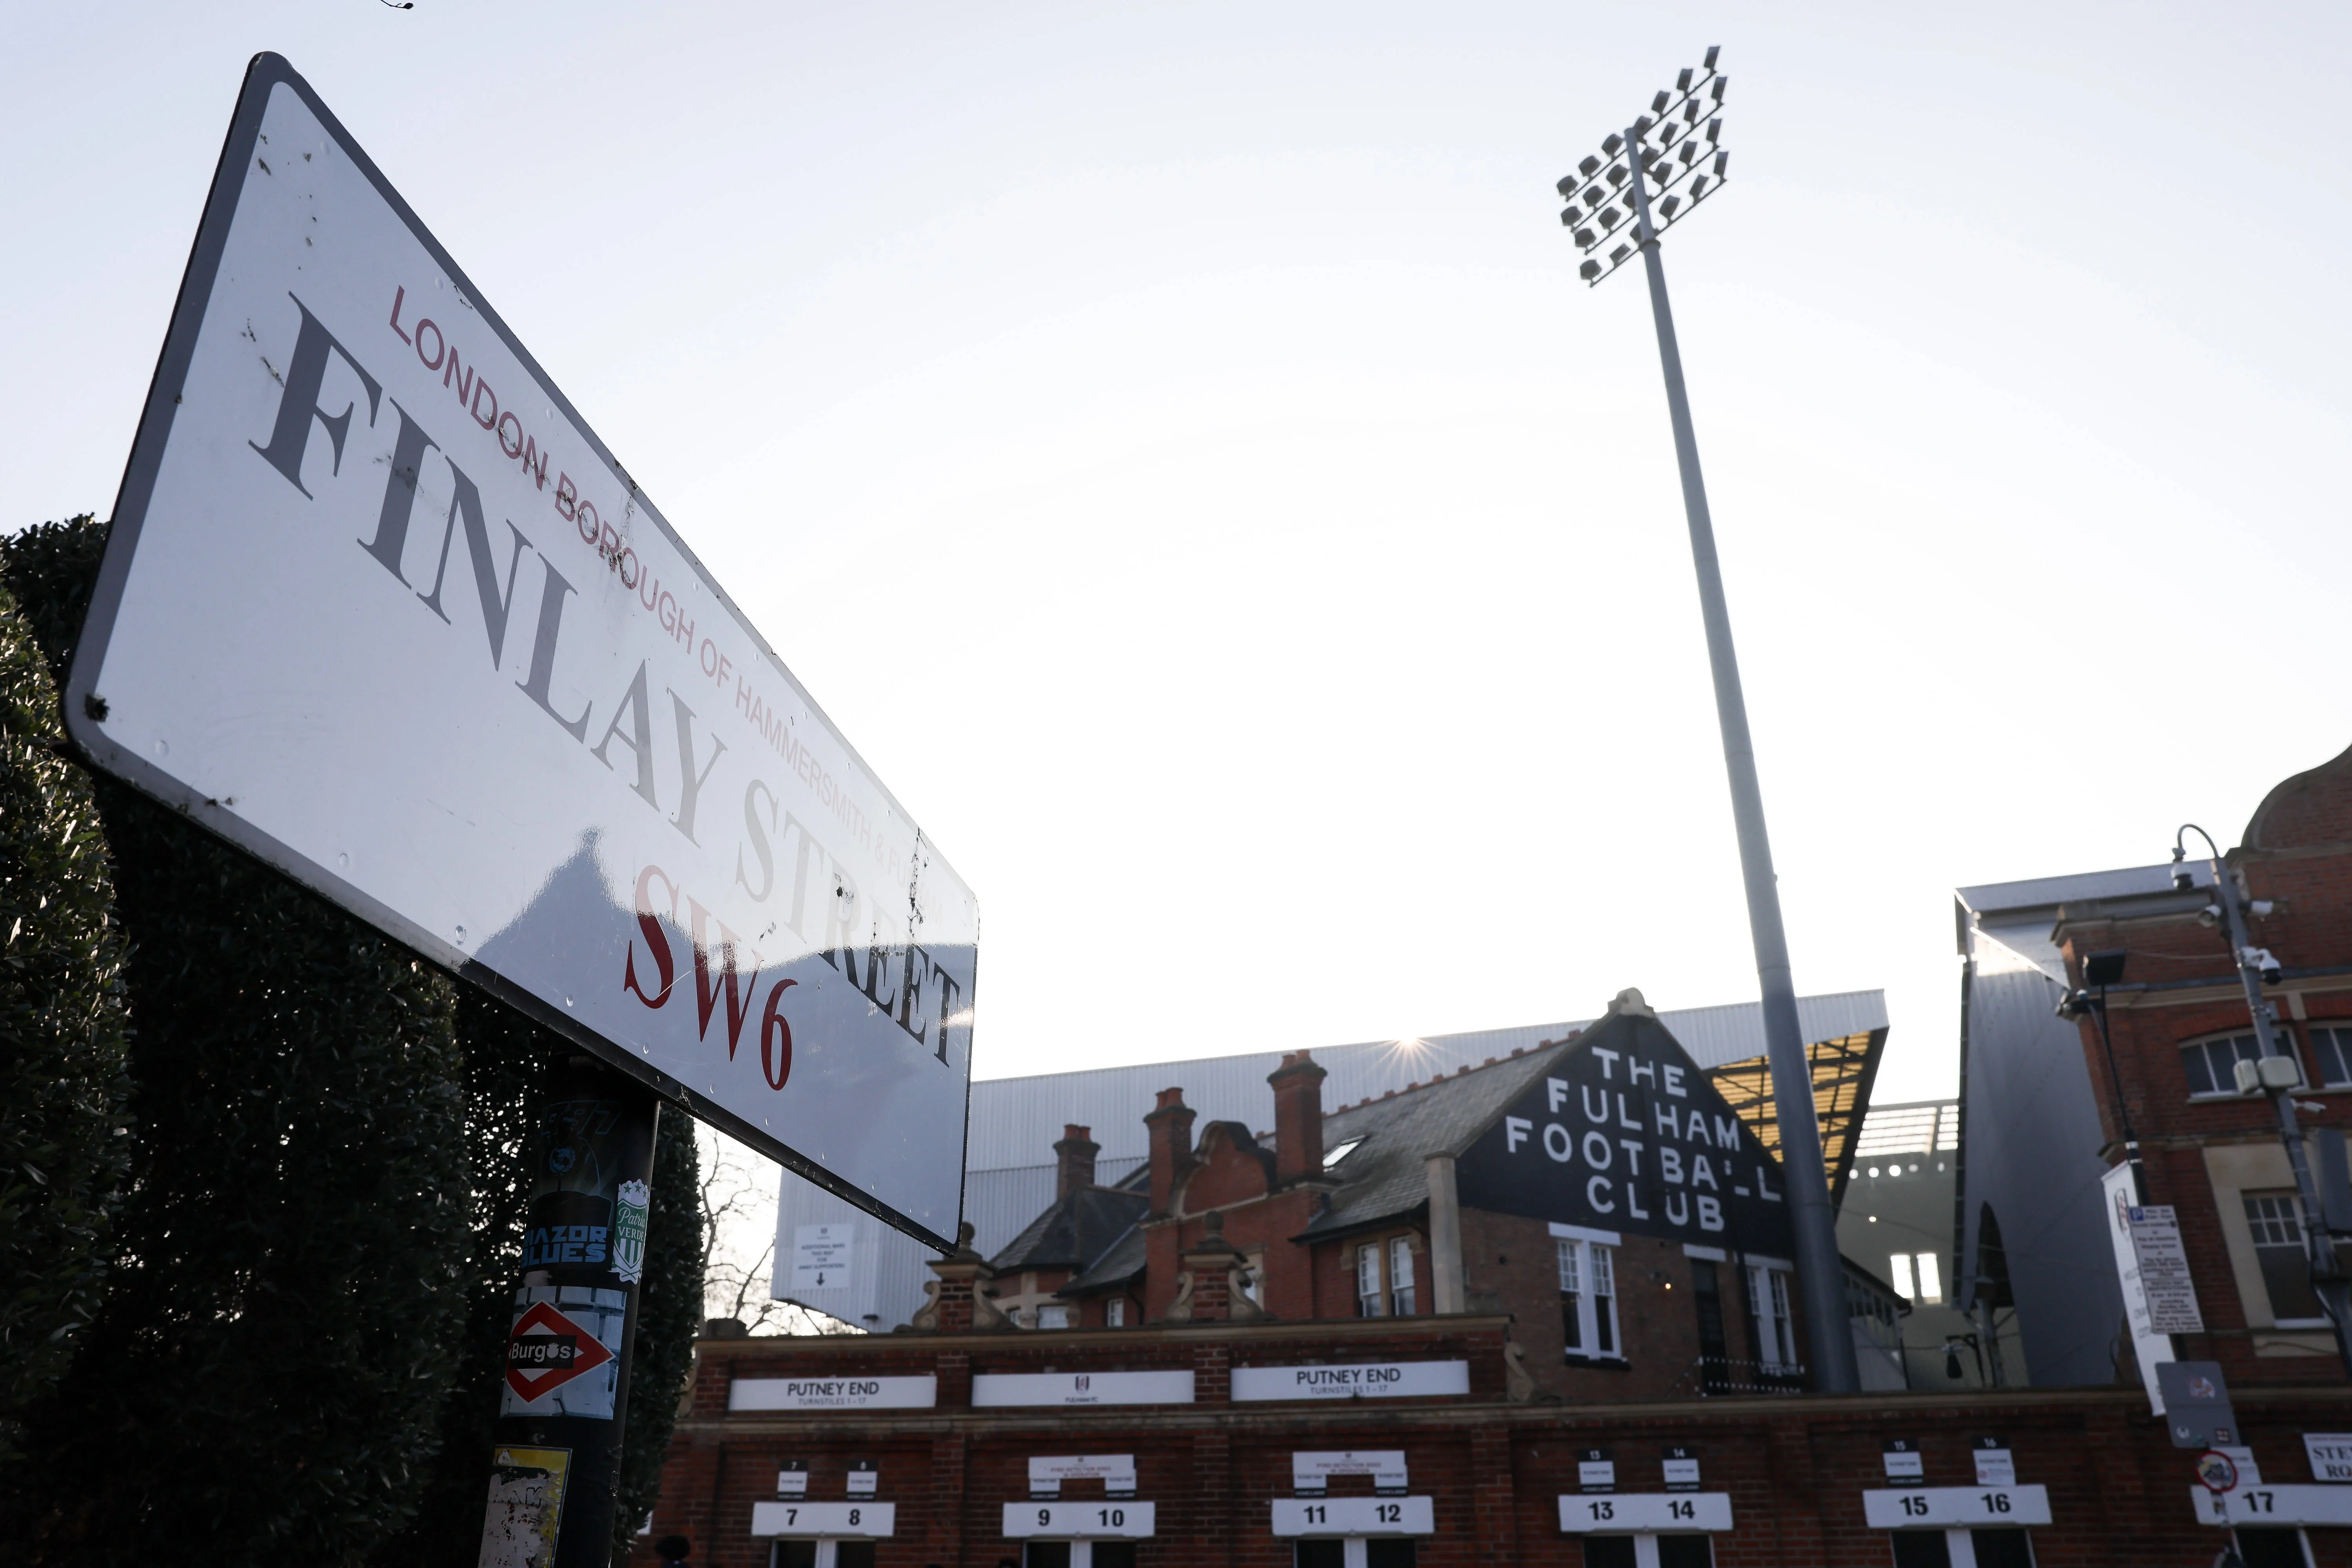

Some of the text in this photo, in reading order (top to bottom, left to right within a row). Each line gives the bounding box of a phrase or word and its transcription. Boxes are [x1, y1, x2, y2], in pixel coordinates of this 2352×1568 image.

[390, 285, 548, 492] LONDON
[555, 471, 694, 655] BOROUGH
[701, 638, 732, 688] OF
[735, 674, 872, 850] HAMMERSMITH
[875, 832, 884, 867] &
[248, 290, 959, 1068] FINLAY STREET
[624, 865, 798, 1091] SW6
[1592, 1046, 1687, 1098] THE
[1547, 1077, 1740, 1152] FULHAM
[1586, 1175, 1725, 1232] CLUB
[617, 1207, 646, 1228] Patria
[618, 1226, 644, 1241] VERDE
[511, 1342, 571, 1363] Burgos
[1297, 1368, 1401, 1385] PUTNEY END
[787, 1381, 879, 1396] PUTNEY END
[1310, 1385, 1363, 1394] TURNSTILES
[1379, 1385, 1388, 1393] 17
[798, 1397, 845, 1406] TURNSTILES
[1895, 1440, 1906, 1451] 15
[1984, 1437, 1997, 1448] 16
[1589, 1450, 1601, 1460] 13
[1673, 1448, 1685, 1458] 14
[791, 1461, 797, 1470] 7
[1588, 1500, 1695, 1520] 13 14
[1899, 1493, 2011, 1516] 15 16
[2242, 1492, 2273, 1513] 17
[786, 1508, 860, 1526] 7 8
[1038, 1508, 1124, 1526] 9 10
[1303, 1504, 1401, 1524] 11 12
